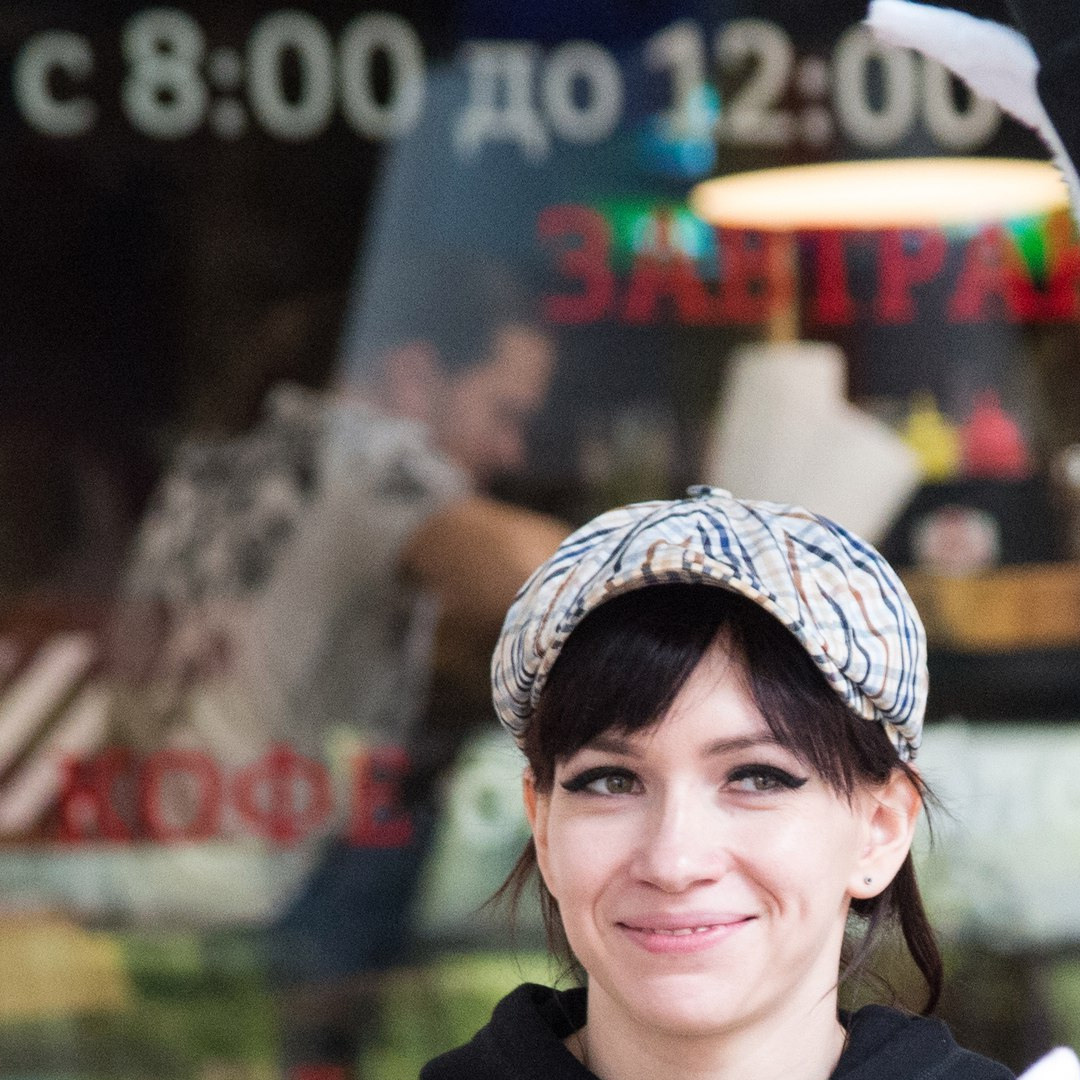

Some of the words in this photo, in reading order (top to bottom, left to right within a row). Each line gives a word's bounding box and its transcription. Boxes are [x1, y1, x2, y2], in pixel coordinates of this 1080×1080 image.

[13, 30, 96, 137] с
[120, 8, 427, 141] 8:00
[452, 38, 625, 162] до
[58, 742, 415, 850] КОФЕ
